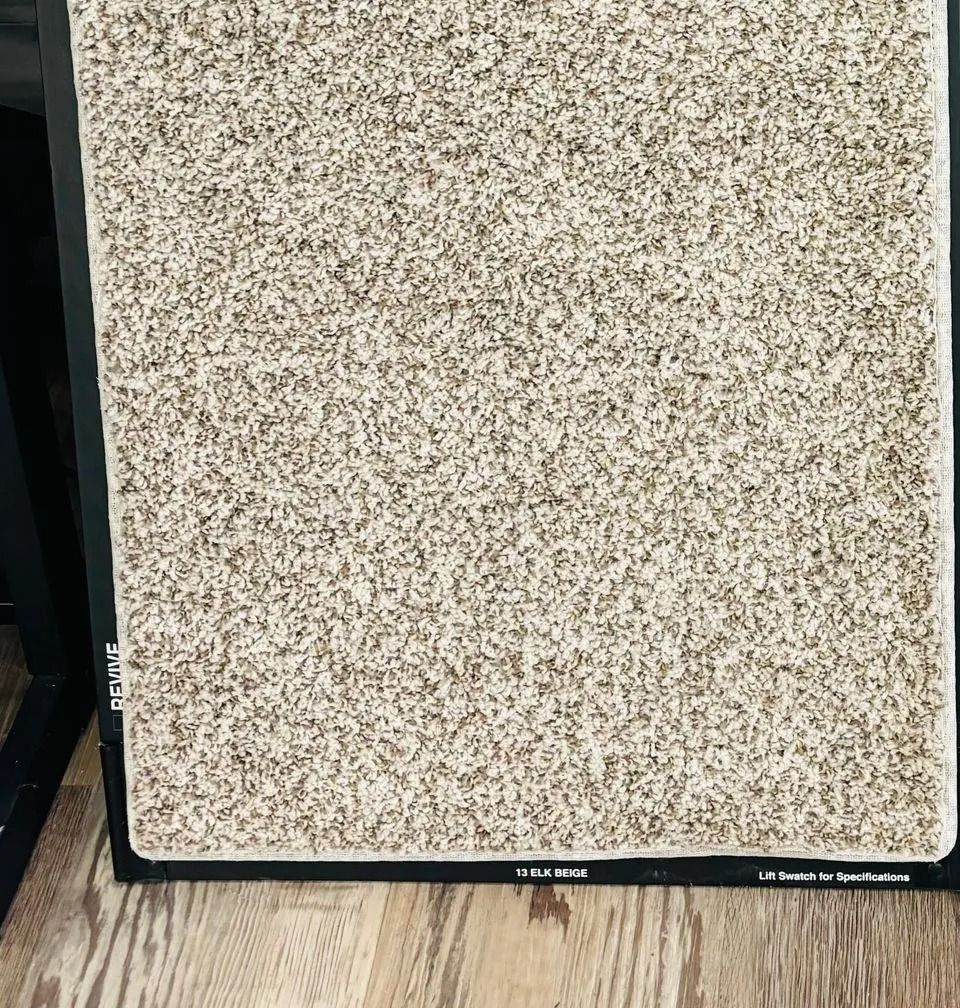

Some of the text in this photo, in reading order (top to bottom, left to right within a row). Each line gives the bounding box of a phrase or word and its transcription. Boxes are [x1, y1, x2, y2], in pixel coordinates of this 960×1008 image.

[515, 868, 588, 878] 13 ELK BEIGE
[758, 871, 911, 884] Lift Swatch for Specifications
